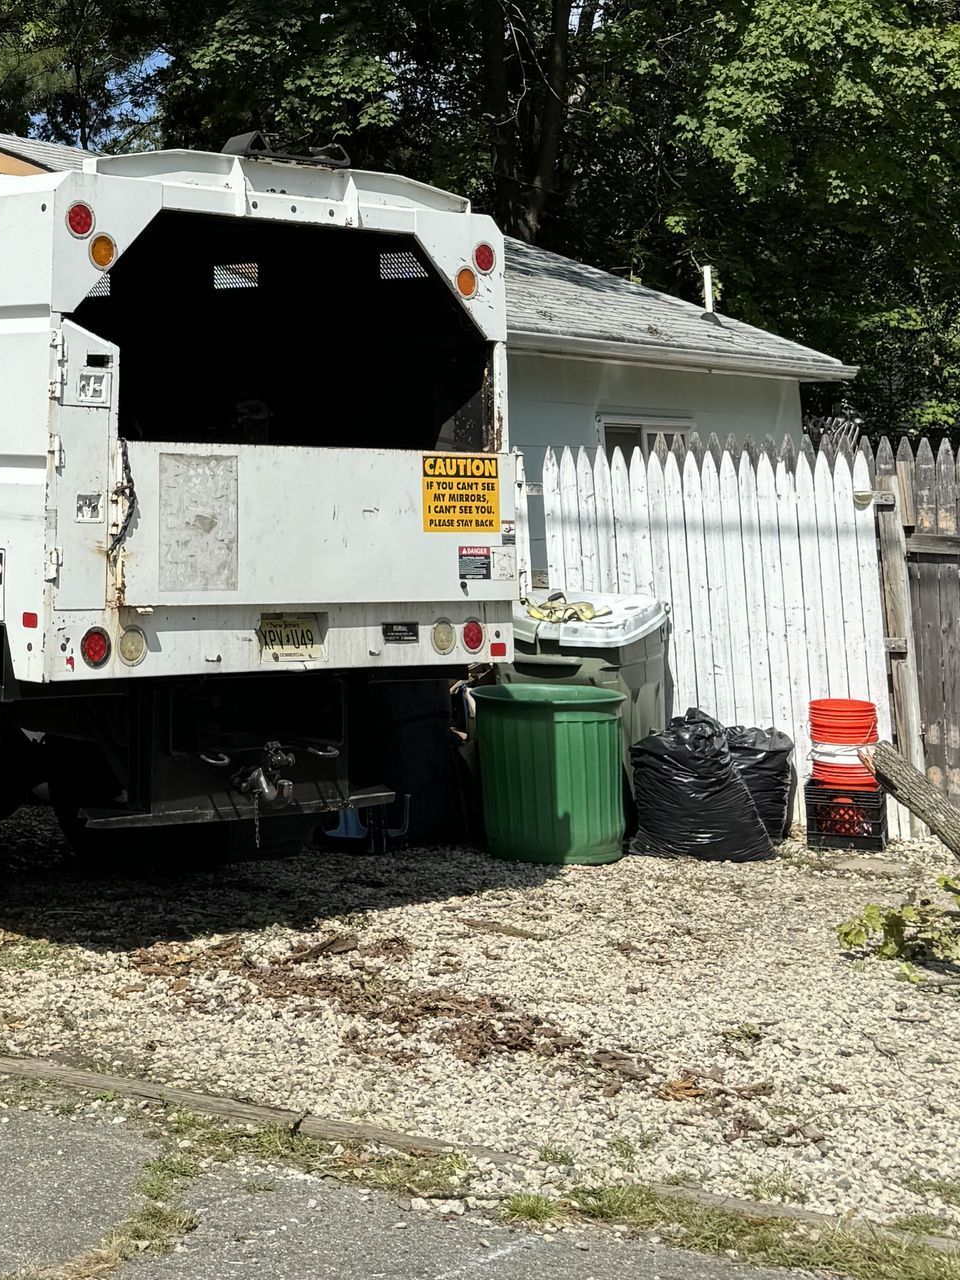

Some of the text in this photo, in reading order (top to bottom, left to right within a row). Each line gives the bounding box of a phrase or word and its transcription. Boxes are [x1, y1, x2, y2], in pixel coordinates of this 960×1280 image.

[424, 458, 497, 477] CAUTION
[426, 481, 496, 491] IF YOU CAN'T SEE
[433, 493, 489, 504] MY MIRRORS,
[434, 505, 457, 514] CAN'T
[459, 505, 473, 514] SEE
[475, 505, 495, 515] YOU.
[429, 519, 494, 528] PLEASE STAY BACK
[261, 629, 314, 650] XPV U49
